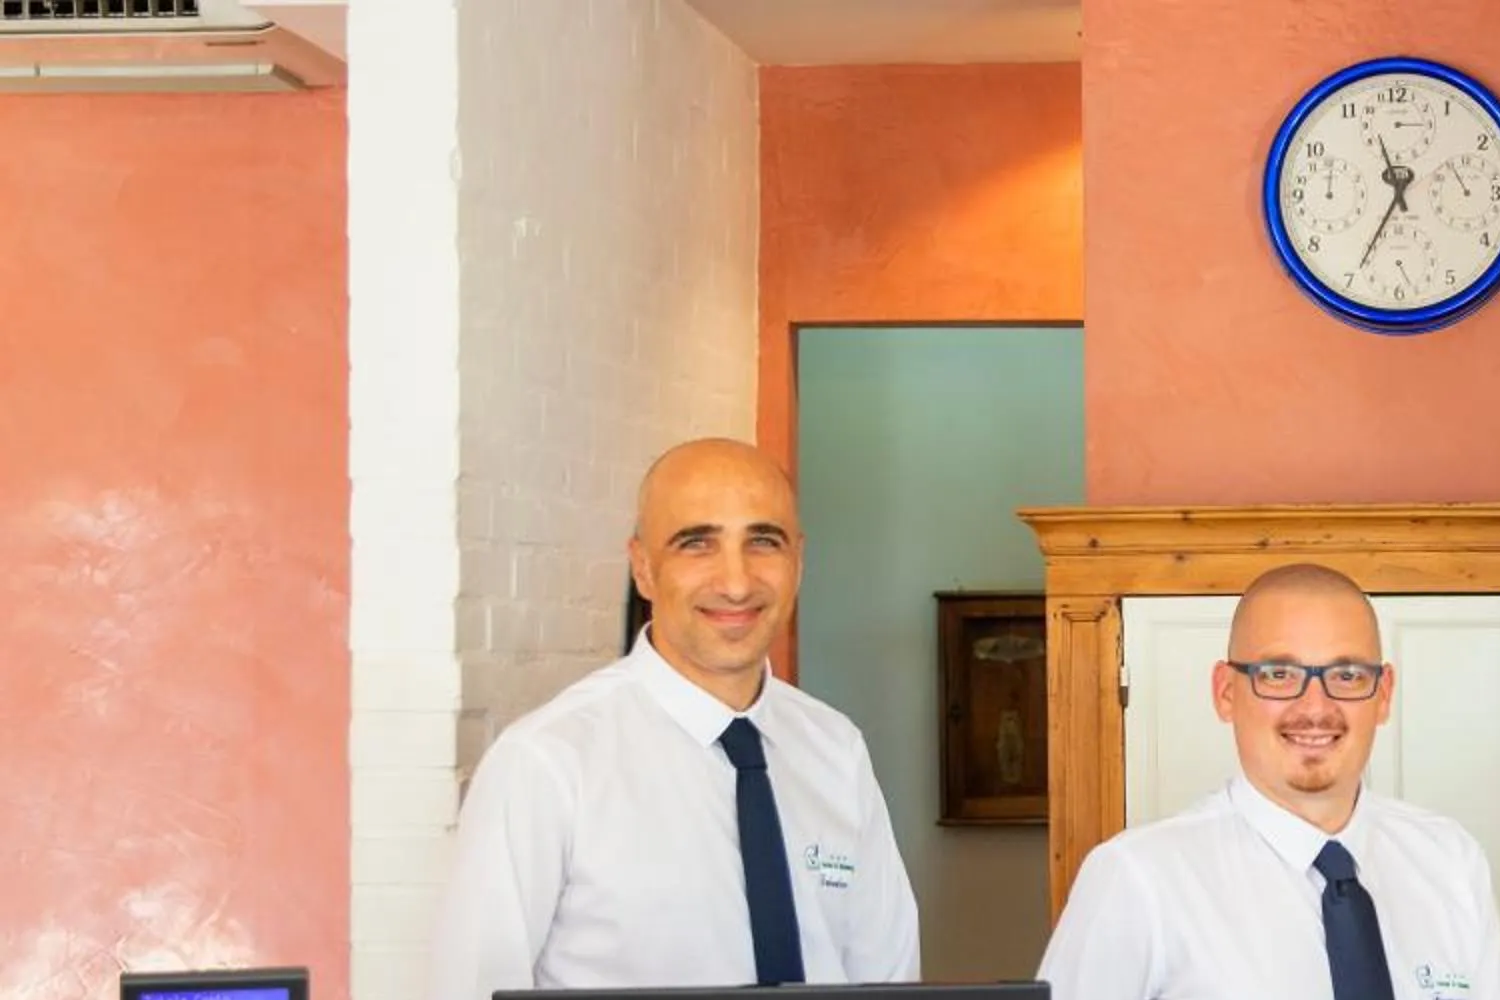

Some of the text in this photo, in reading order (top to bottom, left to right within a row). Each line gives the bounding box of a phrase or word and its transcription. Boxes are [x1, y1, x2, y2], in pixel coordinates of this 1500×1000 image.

[1388, 87, 1407, 103] 12
[1341, 103, 1357, 119] 11
[1444, 101, 1450, 116] 1
[1477, 133, 1489, 151] 2
[1306, 143, 1325, 158] 10
[1292, 188, 1304, 203] 9
[1307, 236, 1321, 252] 8
[1479, 232, 1490, 247] 4
[1343, 272, 1354, 288] 7
[1445, 269, 1456, 285] 5
[1393, 283, 1405, 300] 6
